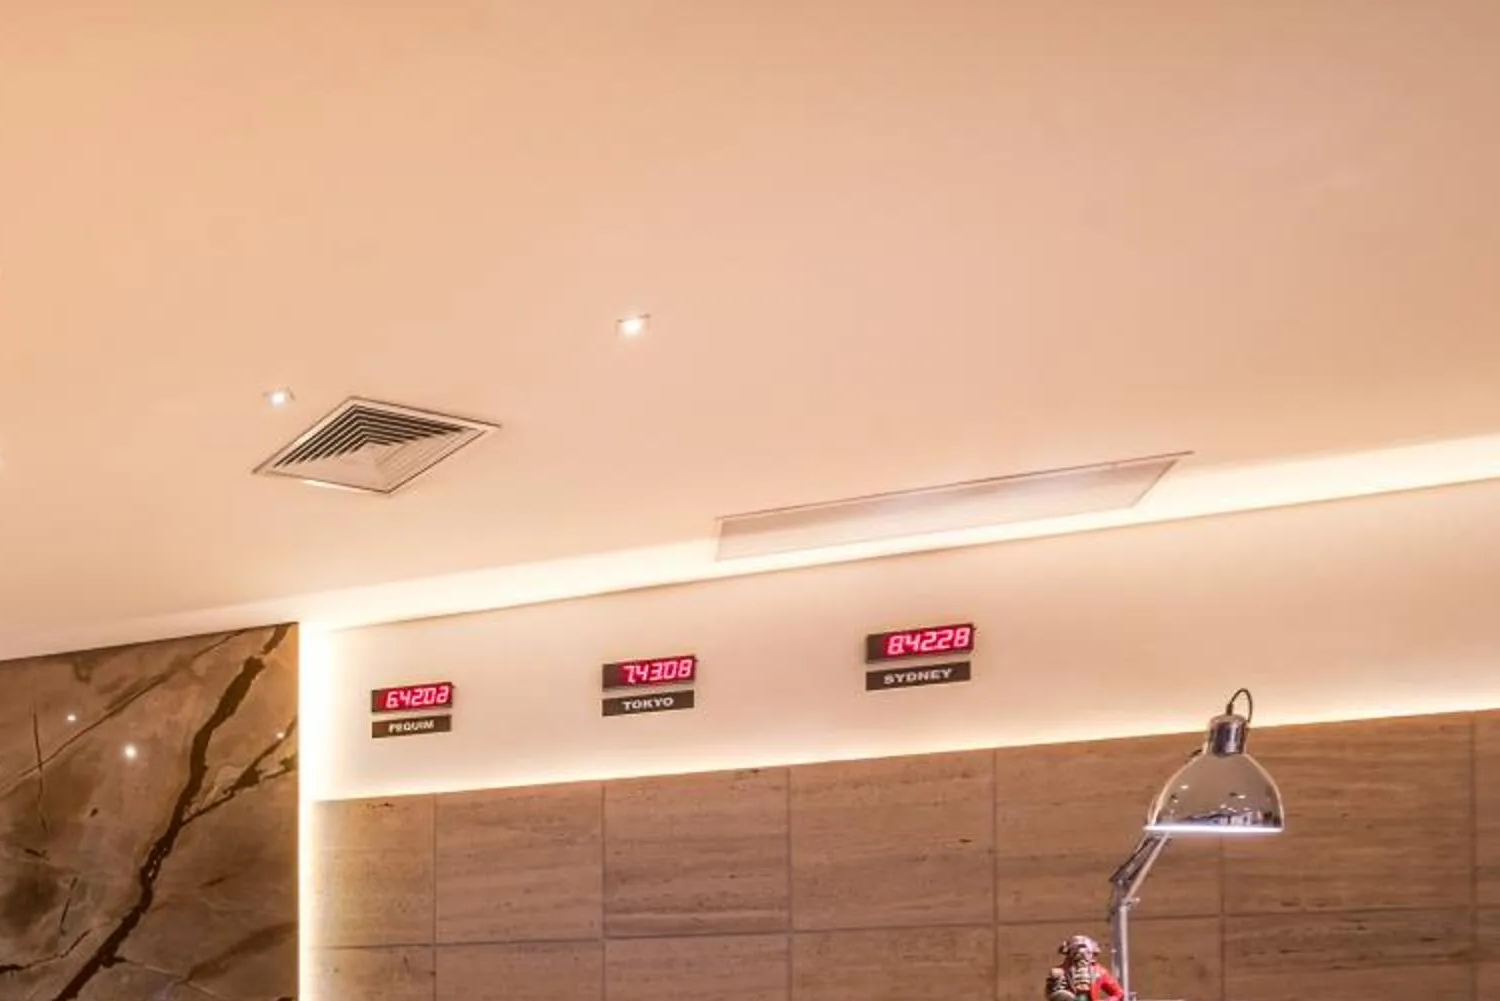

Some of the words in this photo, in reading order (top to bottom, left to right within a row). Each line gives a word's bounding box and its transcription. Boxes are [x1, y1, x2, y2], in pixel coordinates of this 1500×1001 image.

[883, 668, 953, 685] SYDNEY
[622, 697, 675, 711] TOKYO
[388, 719, 435, 733] PEQUIM
